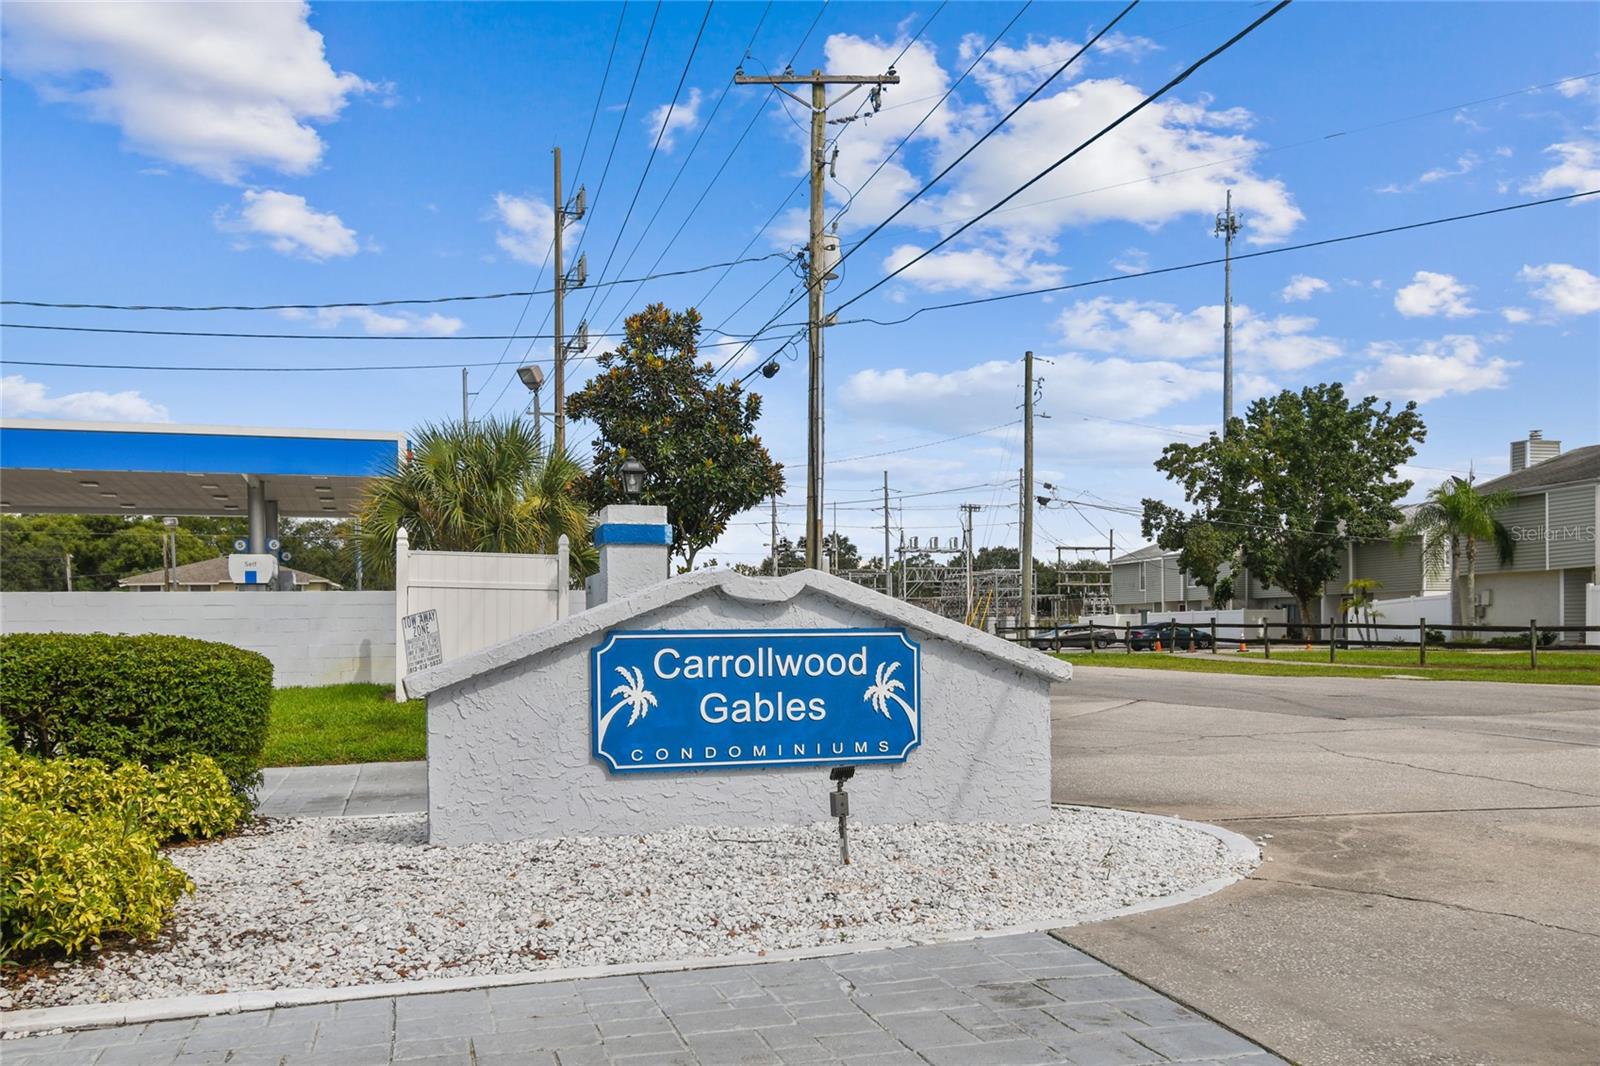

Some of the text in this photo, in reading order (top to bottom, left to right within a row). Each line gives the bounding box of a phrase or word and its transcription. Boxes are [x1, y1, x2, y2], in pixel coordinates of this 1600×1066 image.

[413, 622, 430, 637] ZONE
[653, 646, 868, 679] Carrollwood
[699, 691, 827, 724] Gables
[631, 740, 890, 762] CONDOMINIUMS
